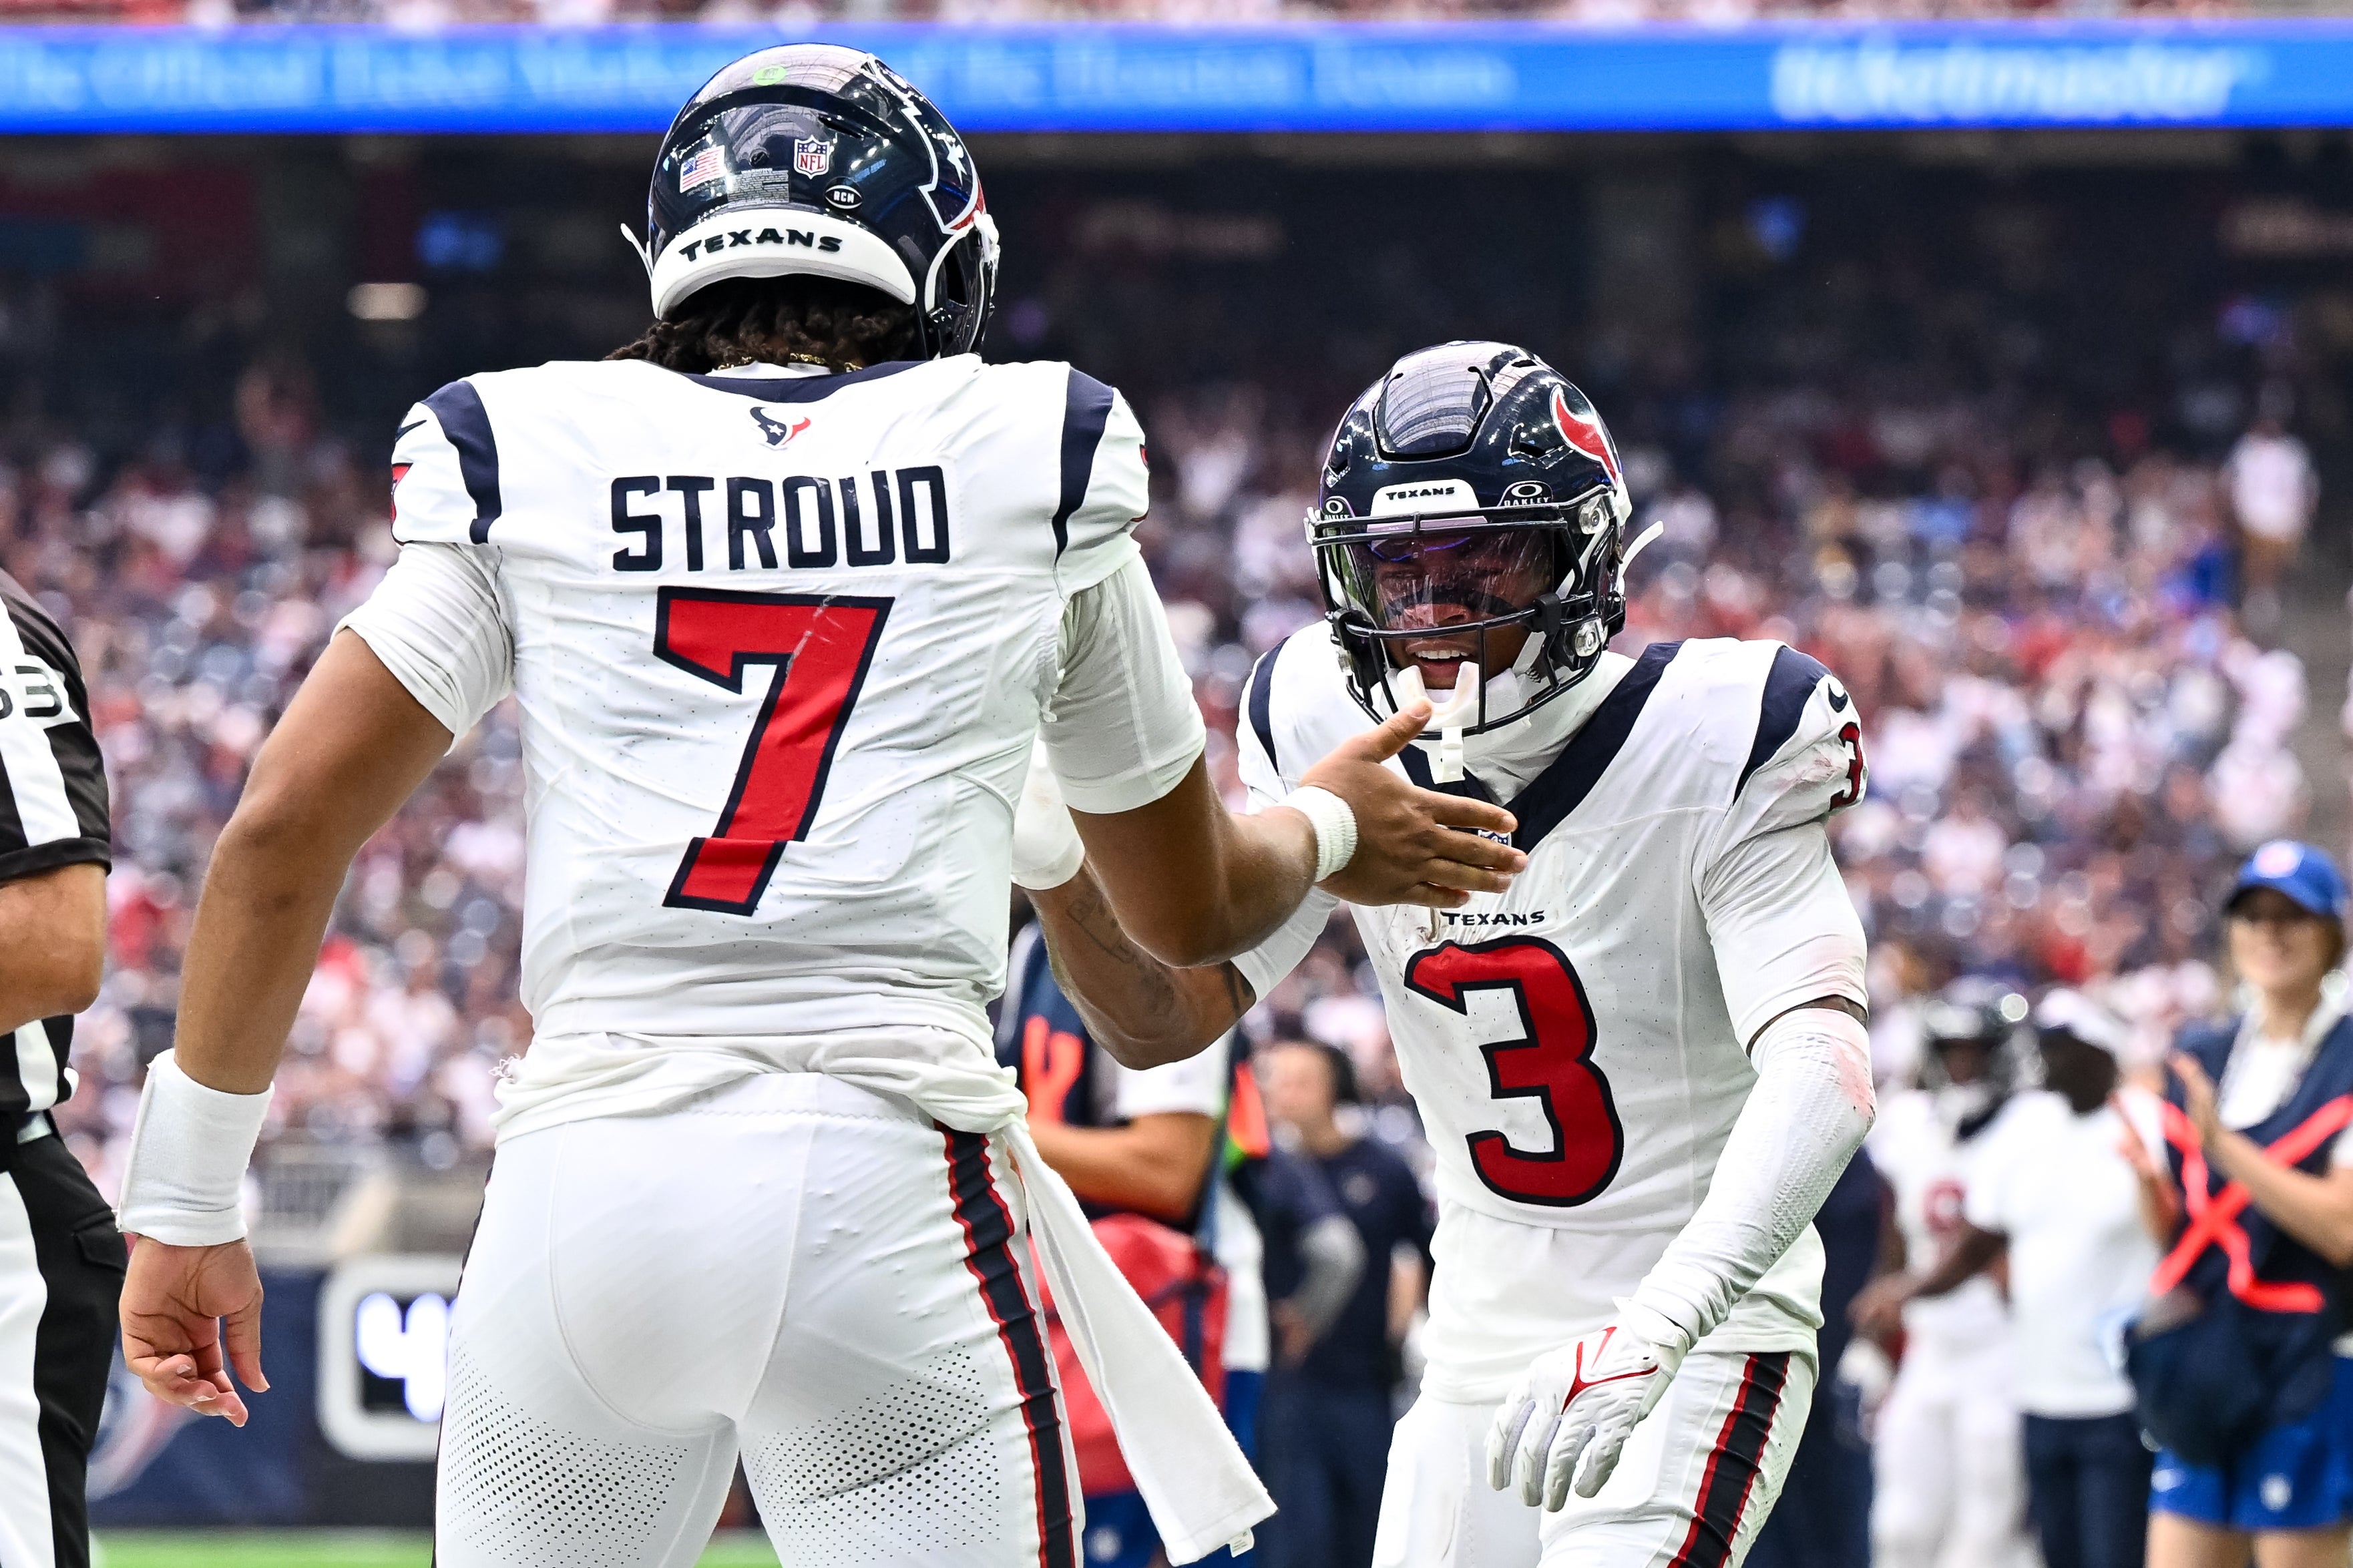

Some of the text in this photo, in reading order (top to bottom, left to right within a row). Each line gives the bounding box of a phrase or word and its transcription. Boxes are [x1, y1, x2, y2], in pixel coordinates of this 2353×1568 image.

[799, 154, 824, 170] NFL
[678, 228, 843, 262] TEXANS
[1385, 487, 1456, 501] TEXANS
[1504, 496, 1549, 507] OAKLEY
[611, 465, 950, 572] STROUD
[654, 586, 895, 917] 7
[1441, 910, 1545, 927] TEXANS
[1404, 935, 1624, 1208] 3
